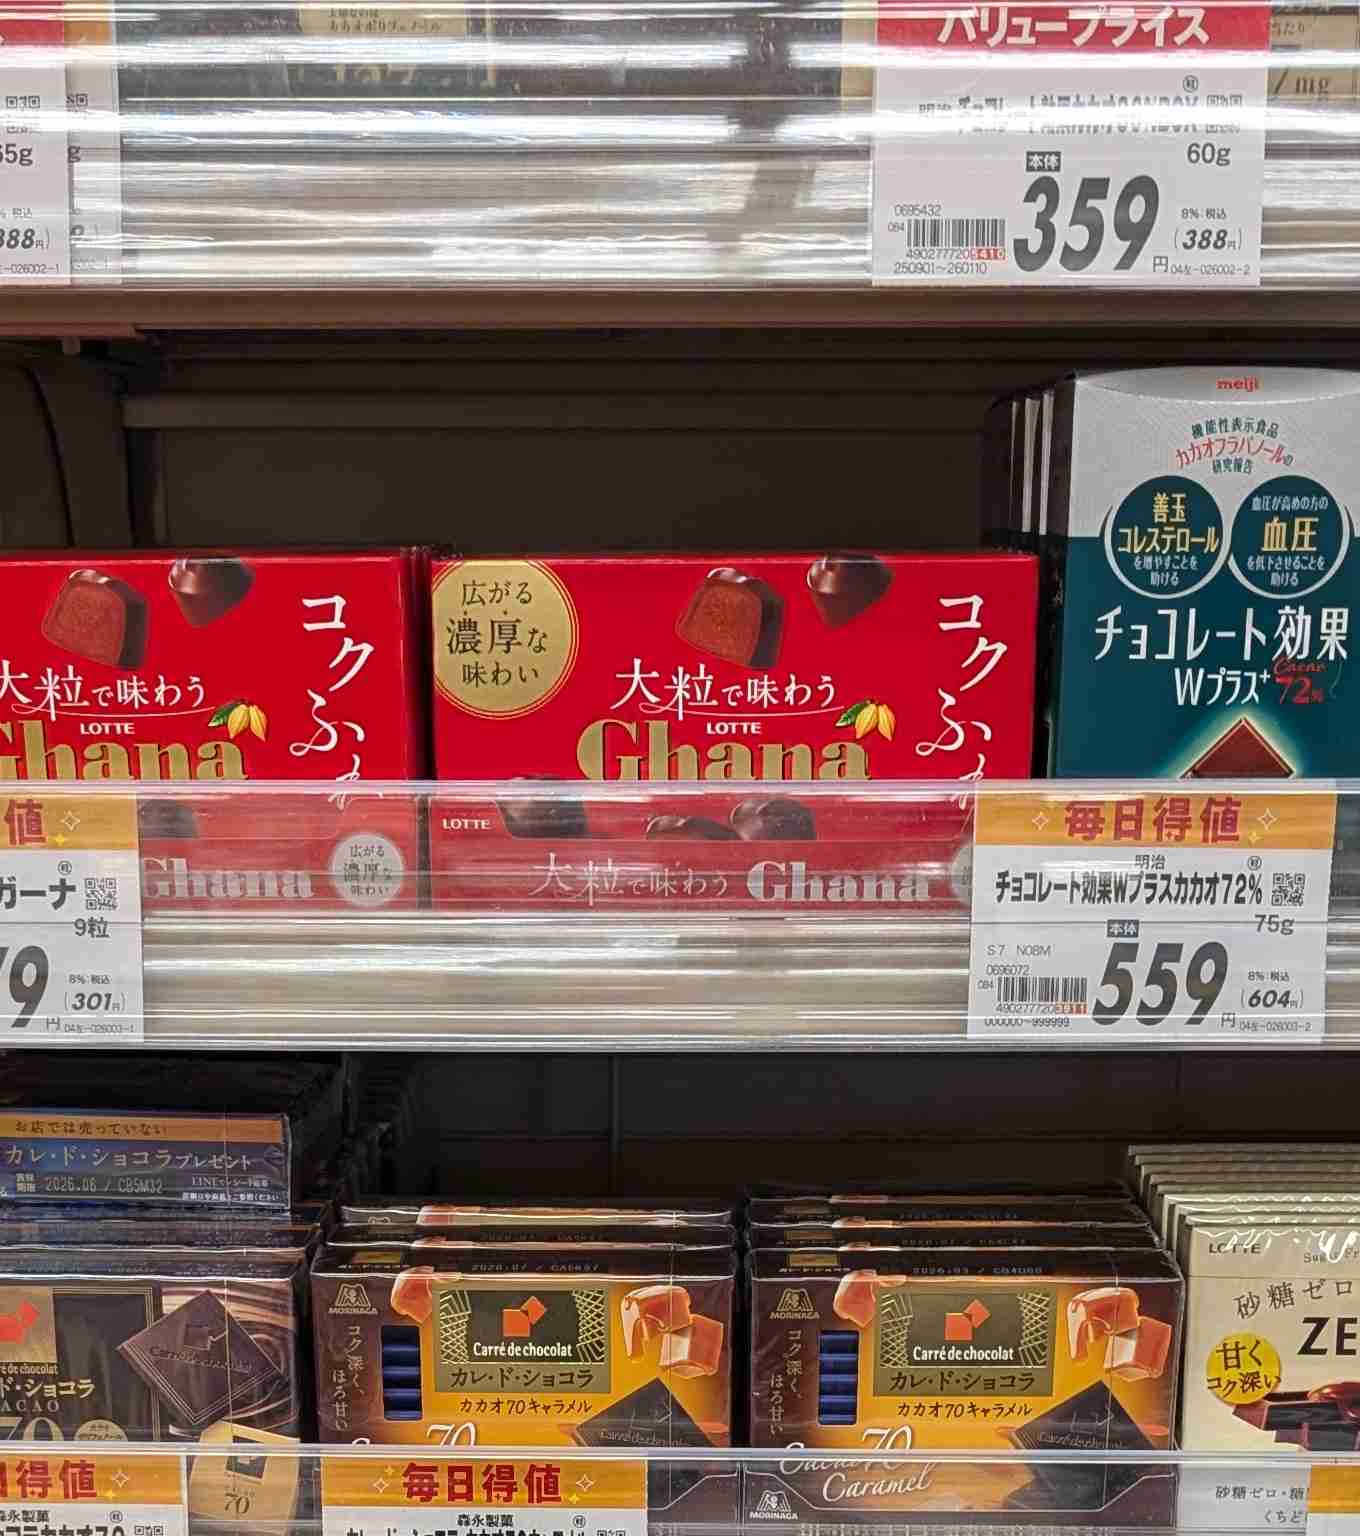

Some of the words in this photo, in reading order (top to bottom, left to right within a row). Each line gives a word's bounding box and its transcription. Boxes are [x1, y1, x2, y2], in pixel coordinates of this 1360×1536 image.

[939, 5, 1209, 48] バリュープライス
[1187, 142, 1231, 166] 60g
[1012, 175, 1161, 272] 359
[1119, 527, 1219, 554] コレステロール
[1263, 517, 1318, 552] 血圧
[461, 580, 533, 606] 広がる
[1095, 606, 1349, 662] チョコレート効果
[461, 662, 539, 687] 味わい
[80, 722, 135, 735] LOTTE
[706, 721, 761, 735] LOTTE
[994, 870, 1264, 907] チョコレート効果Wプラスカカオ72%
[74, 917, 109, 939] 9粒
[1255, 913, 1295, 936] 75g
[1091, 940, 1229, 1025] 559
[1216, 1341, 1265, 1370] 甘く
[450, 1368, 595, 1389] カレ・ド・ショコラ
[890, 1371, 1035, 1392] カレ・ド・ショコラ
[460, 1398, 592, 1414] カカオ70キャラメル
[897, 1402, 1032, 1418] カカオ70キャラメル
[822, 1462, 938, 1502] Caramel
